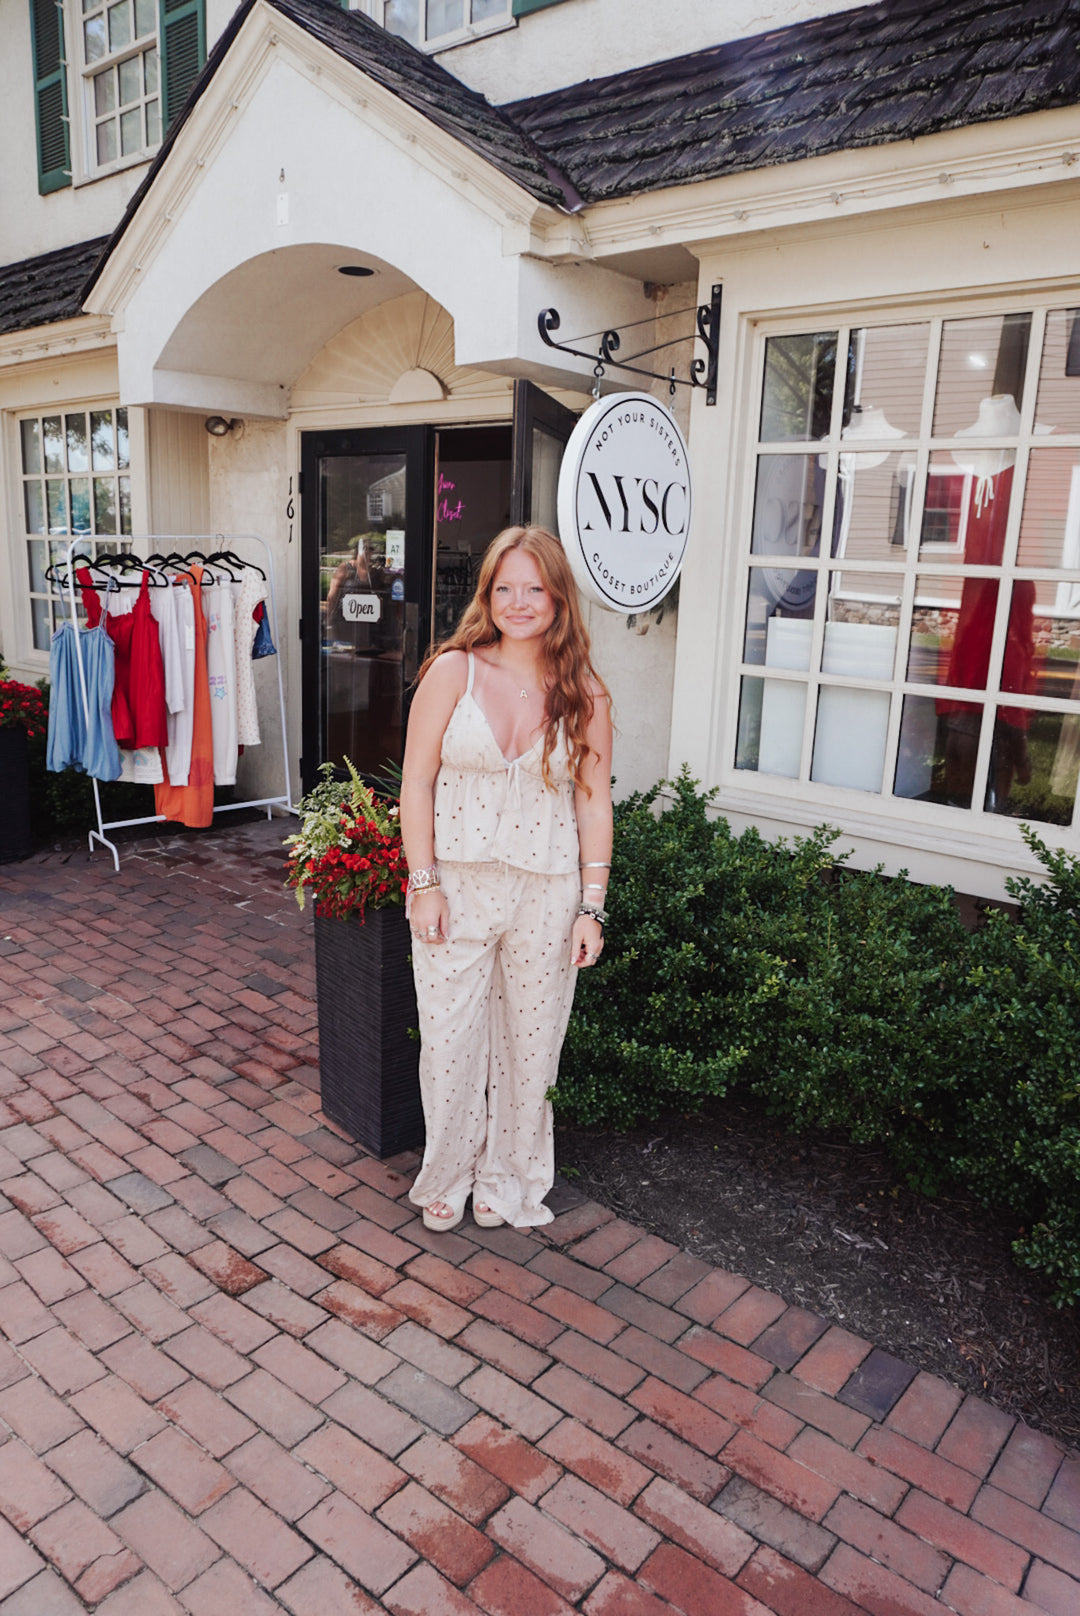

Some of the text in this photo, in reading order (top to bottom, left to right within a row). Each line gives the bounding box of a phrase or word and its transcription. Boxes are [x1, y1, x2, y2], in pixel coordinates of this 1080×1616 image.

[595, 412, 681, 467] NOT YOUR SISTERS
[583, 471, 687, 536] NYSC
[593, 551, 674, 594] CLOSET BOUTIQUE
[347, 599, 375, 619] Open
